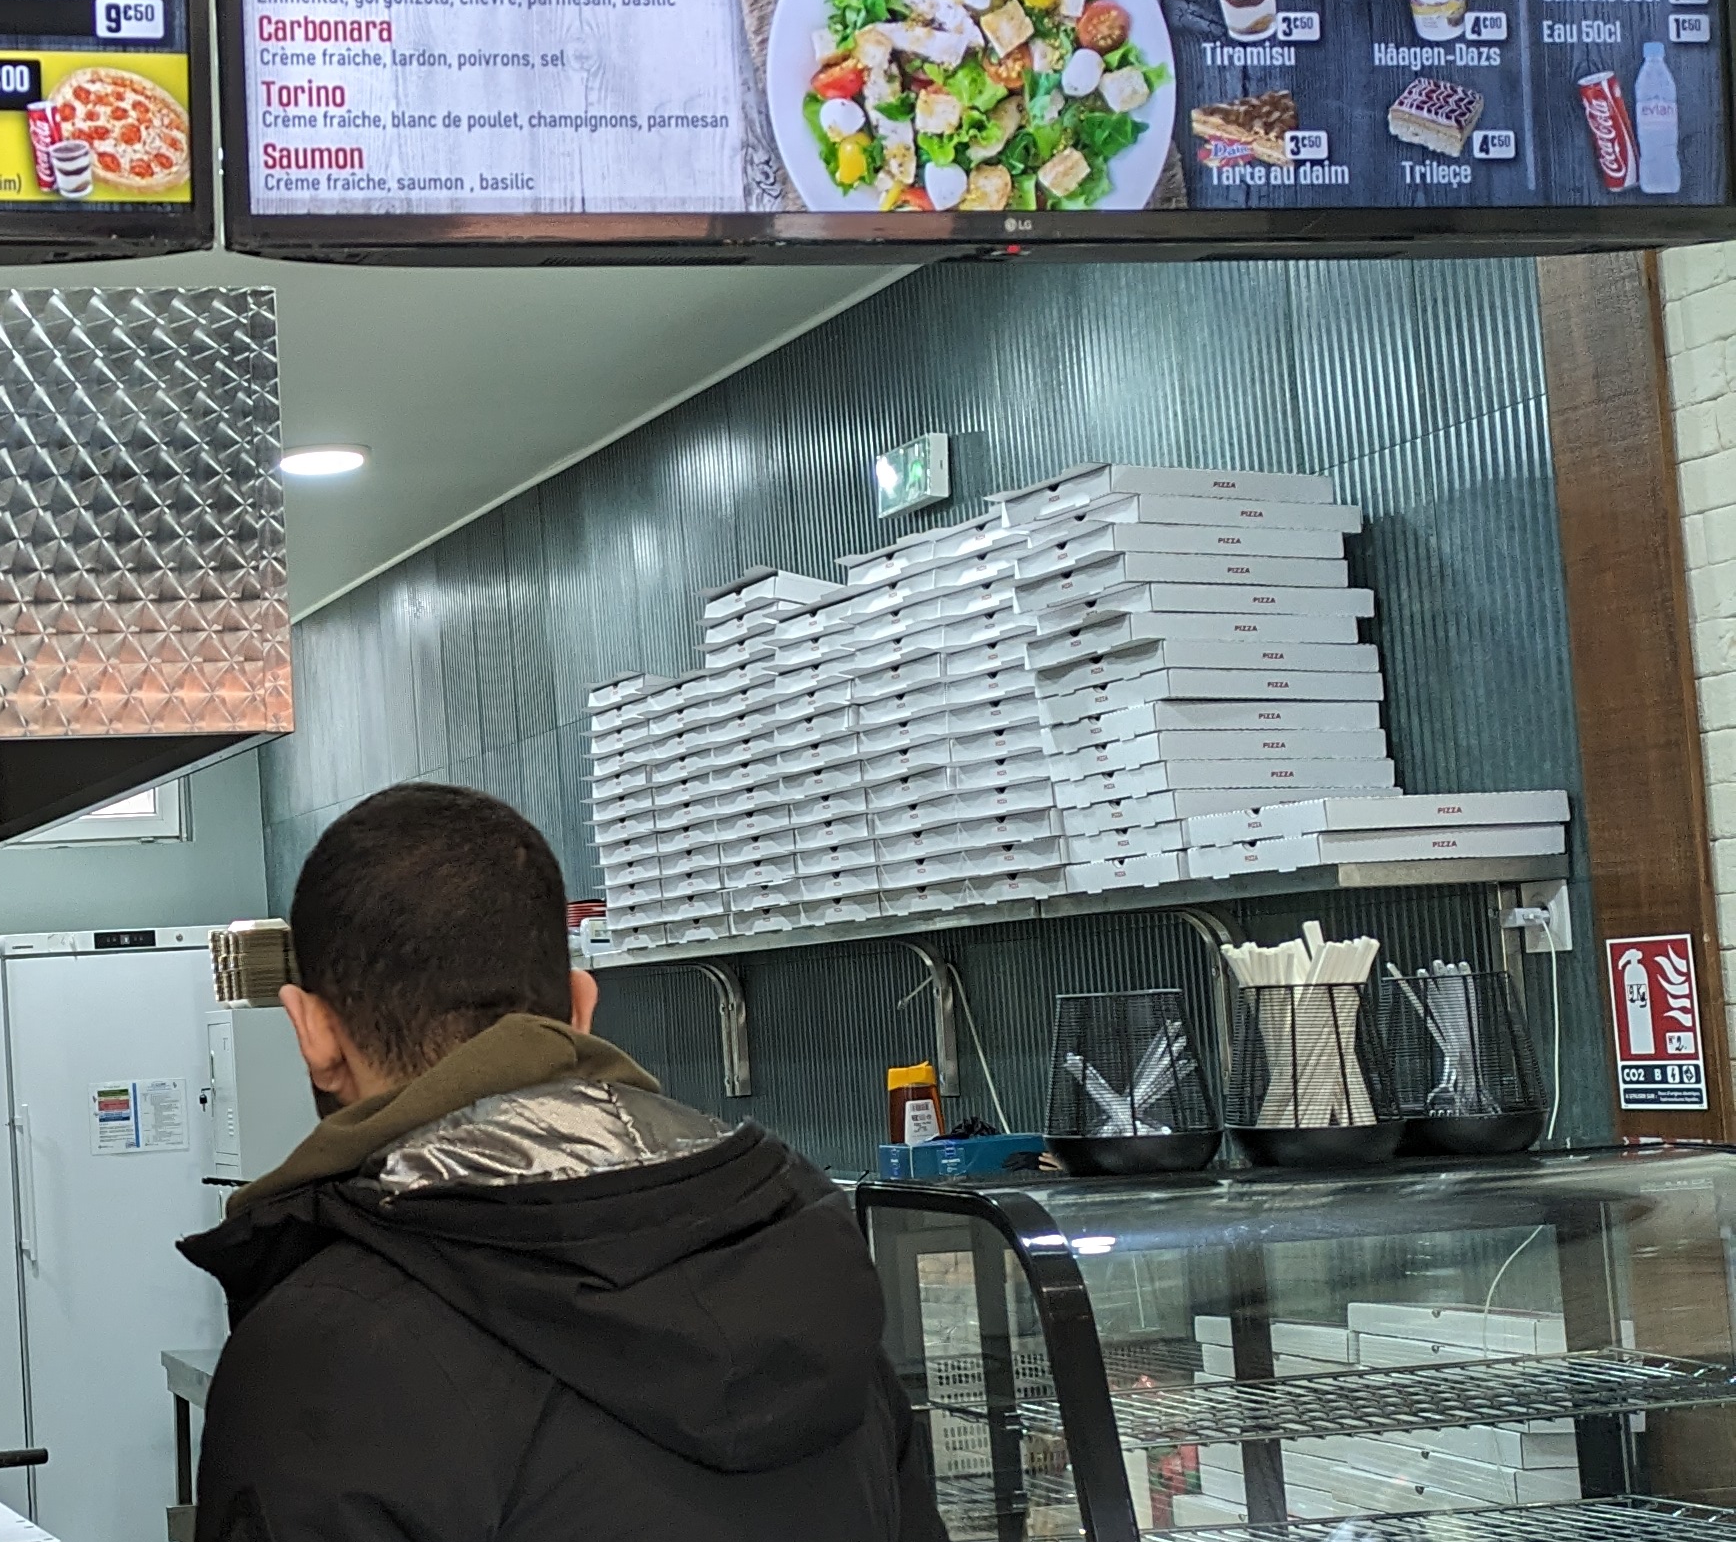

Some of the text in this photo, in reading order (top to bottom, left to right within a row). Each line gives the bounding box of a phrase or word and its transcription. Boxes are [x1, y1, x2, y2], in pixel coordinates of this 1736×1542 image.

[106, 4, 155, 33] 9€50
[259, 15, 393, 42] Carbonara
[1543, 20, 1621, 44] Eau 50cl
[1202, 43, 1296, 66] Tiramisu
[261, 80, 345, 107] Torino
[263, 144, 364, 170] Saumon
[1402, 162, 1472, 187] Trileçe
[1018, 220, 1032, 230] LG
[1214, 481, 1236, 489] PIZZA
[1218, 537, 1241, 545] PIZZA
[1623, 1069, 1662, 1081] CO2 B
